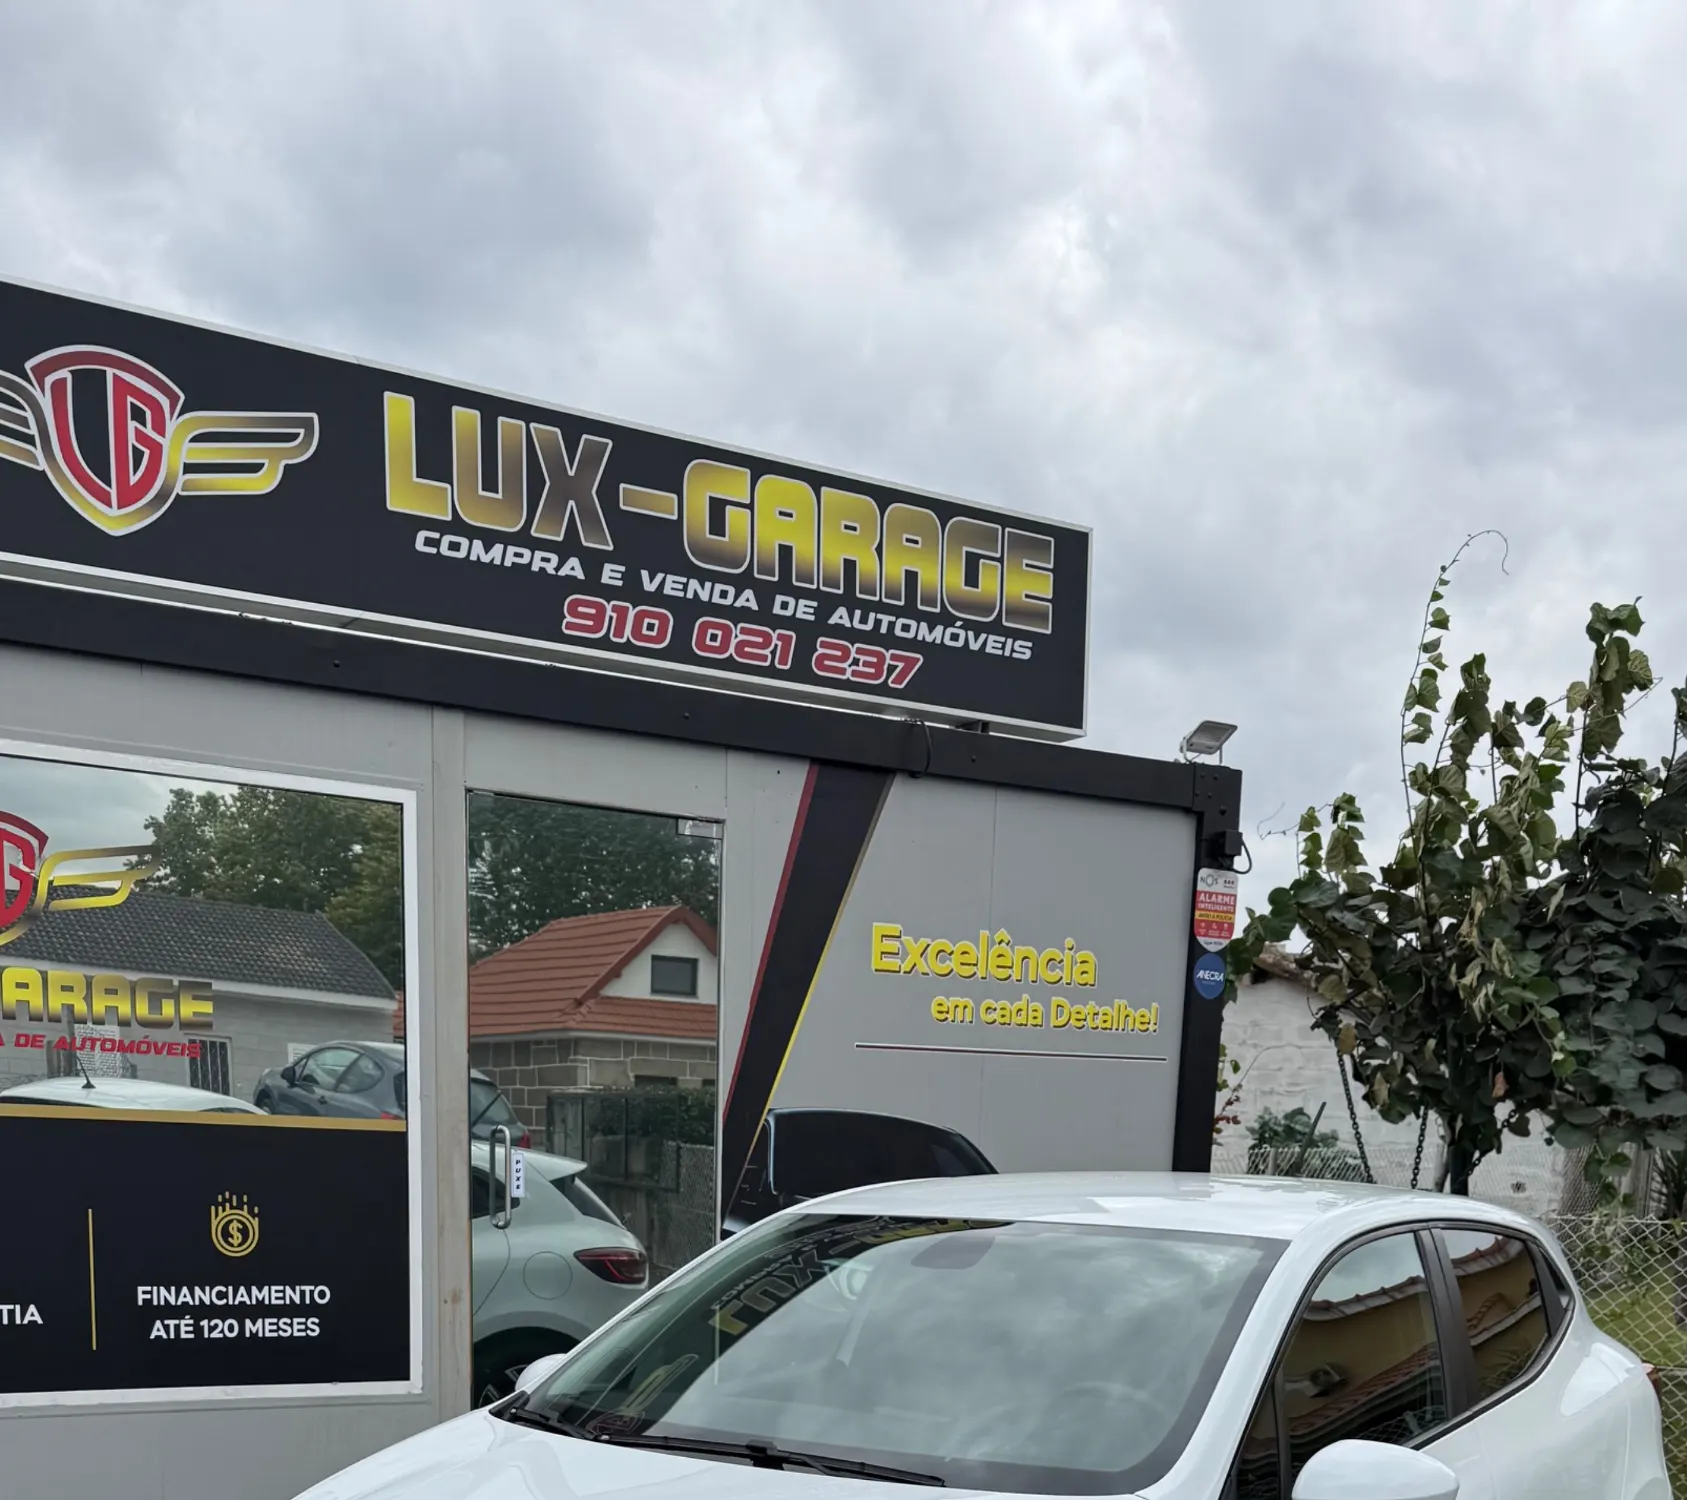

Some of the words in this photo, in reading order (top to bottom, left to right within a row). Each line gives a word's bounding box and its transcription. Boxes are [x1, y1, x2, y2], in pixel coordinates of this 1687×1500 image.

[384, 391, 1055, 634] LUX-GARAGE
[415, 530, 585, 580] COMPRA
[600, 562, 626, 586] E
[640, 569, 759, 611] VENDA
[772, 594, 818, 621] DE
[827, 606, 1033, 660] AUTOMÓVEIS
[561, 594, 673, 649] 910
[692, 616, 796, 670] 021
[812, 636, 923, 689] 237
[871, 922, 1098, 987] Excelência
[1, 966, 214, 1030] ARAGE
[931, 996, 974, 1024] em
[980, 994, 1043, 1028] cada
[1050, 996, 1159, 1035] Detalhe!
[15, 1033, 45, 1049] DE
[53, 1036, 201, 1058] AUTOMÓVEIS
[0, 1304, 43, 1325] TIA
[137, 1286, 331, 1306] FINANCIAMENTO
[150, 1315, 195, 1339] ATÉ
[200, 1319, 238, 1338] 120
[245, 1318, 320, 1338] MESES
